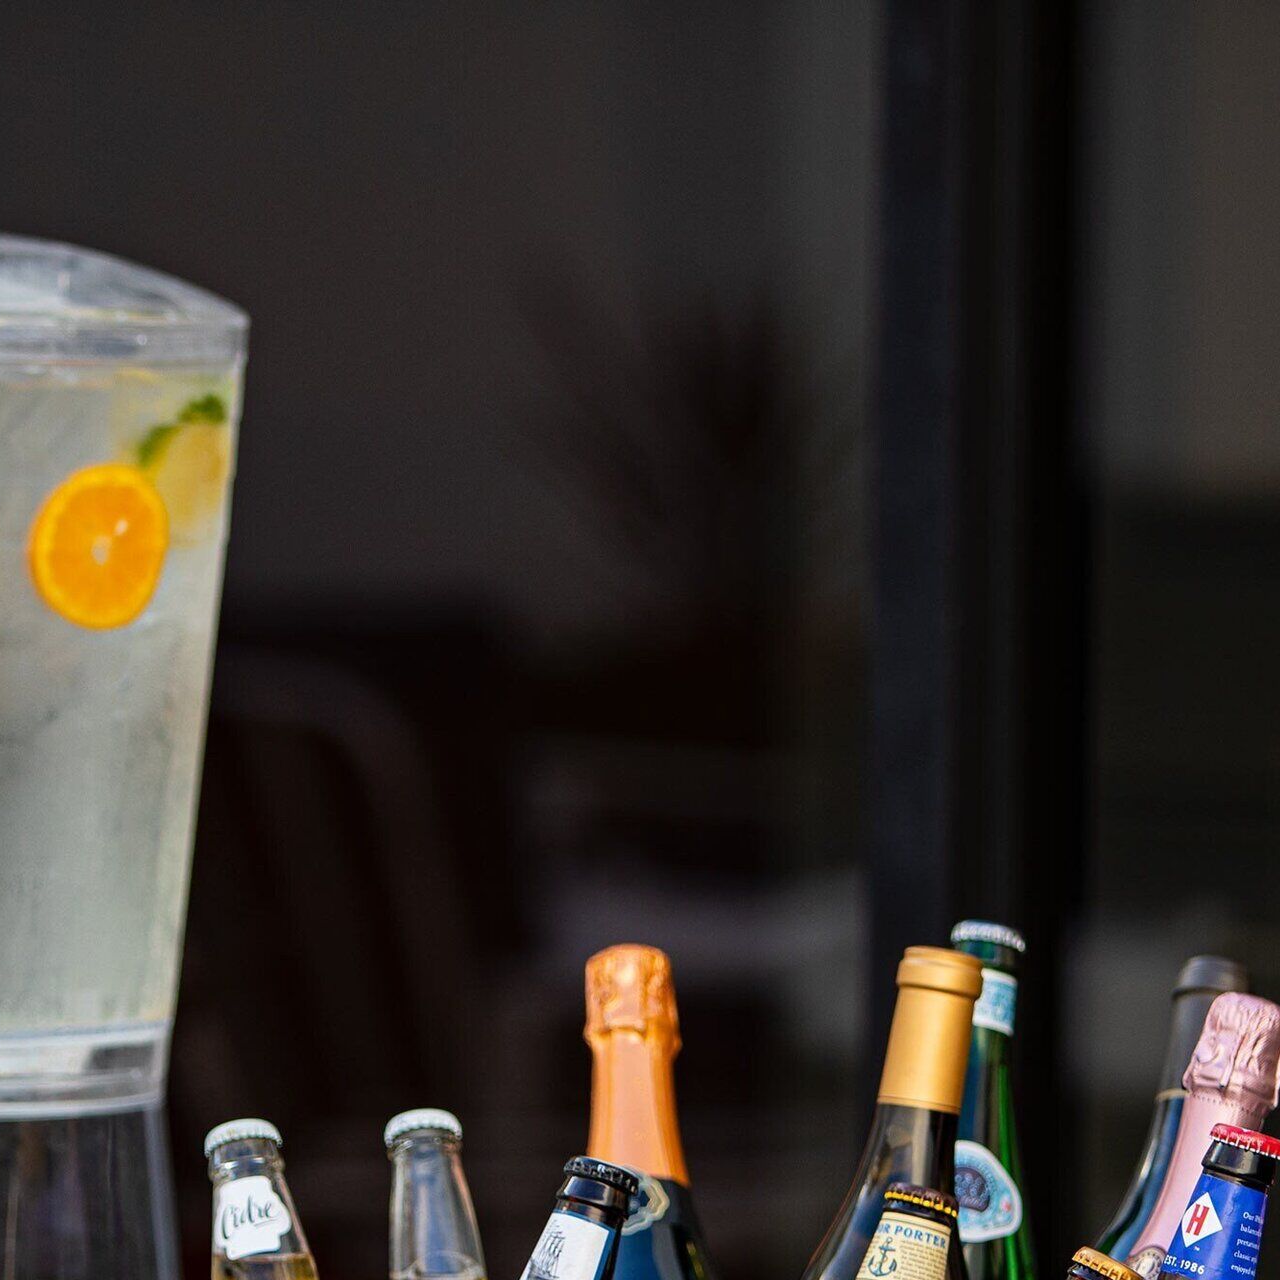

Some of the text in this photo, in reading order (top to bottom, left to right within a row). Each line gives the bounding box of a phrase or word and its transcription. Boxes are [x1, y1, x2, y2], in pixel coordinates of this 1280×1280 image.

[222, 1193, 277, 1240] Cidre
[894, 1225, 946, 1249] PORTER
[1180, 1258, 1206, 1275] 1986
